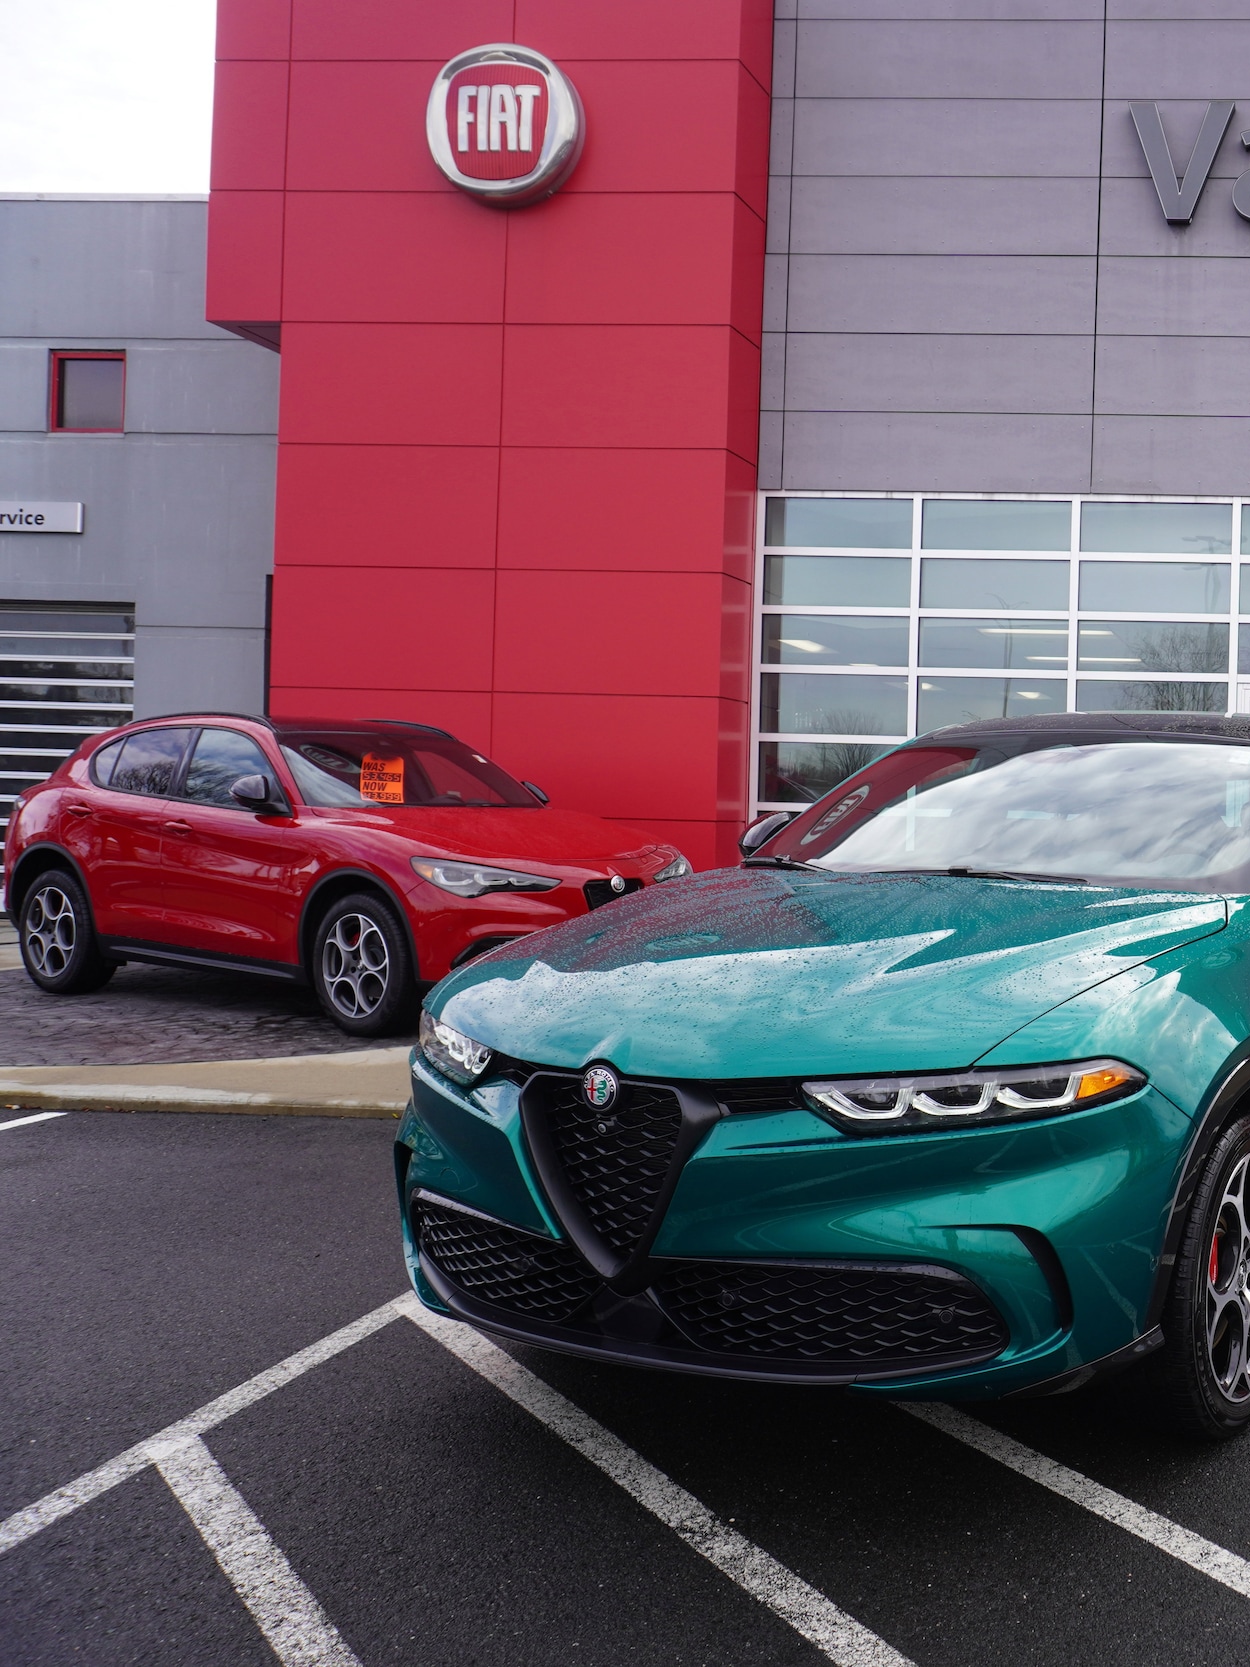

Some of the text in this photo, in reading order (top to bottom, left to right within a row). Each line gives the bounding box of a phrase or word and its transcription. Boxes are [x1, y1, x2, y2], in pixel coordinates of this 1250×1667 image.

[457, 84, 541, 152] FIAT
[363, 762, 386, 771] WAS
[362, 782, 387, 791] NOW
